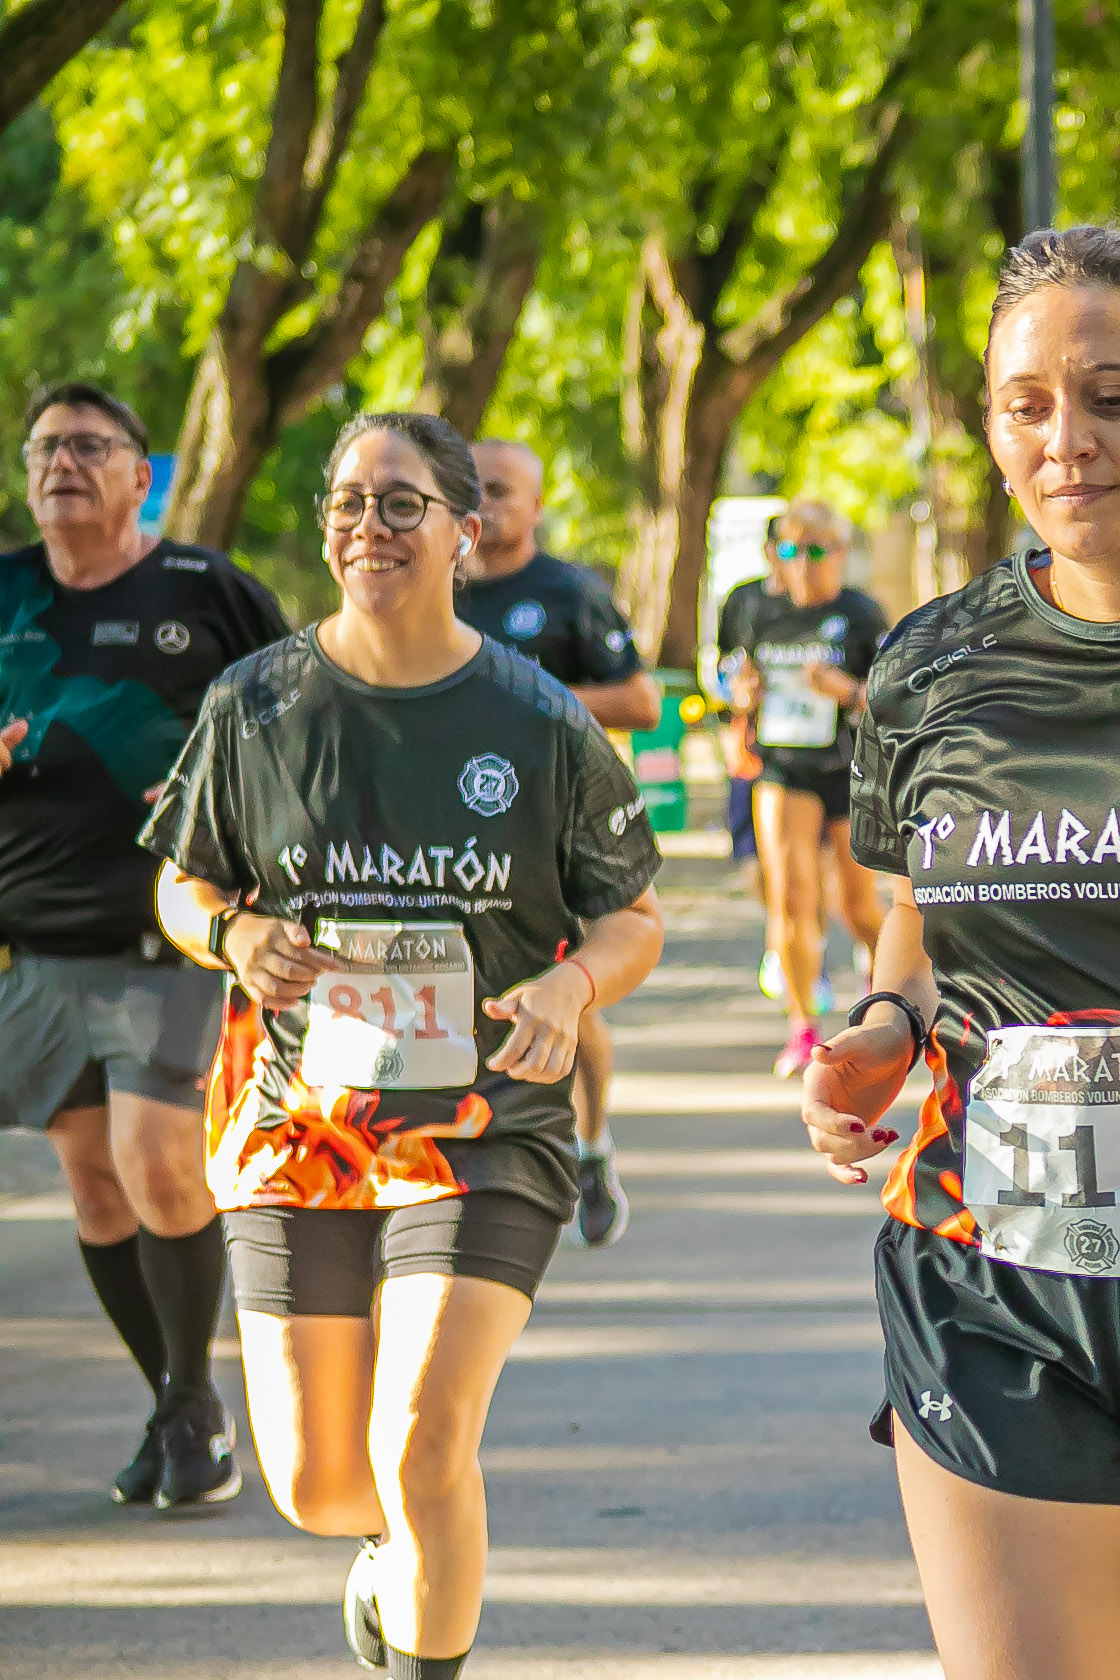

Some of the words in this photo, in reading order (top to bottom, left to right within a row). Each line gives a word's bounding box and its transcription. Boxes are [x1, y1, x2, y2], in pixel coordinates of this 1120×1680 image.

[279, 843, 307, 886] 1º
[326, 835, 511, 892] MARATÓN
[978, 883, 1071, 901] BOMBEROS
[347, 932, 446, 960] MARATÓN
[328, 983, 449, 1040] 811
[1031, 1088, 1085, 1104] BOMBEROS
[1079, 1235, 1102, 1254] 27
